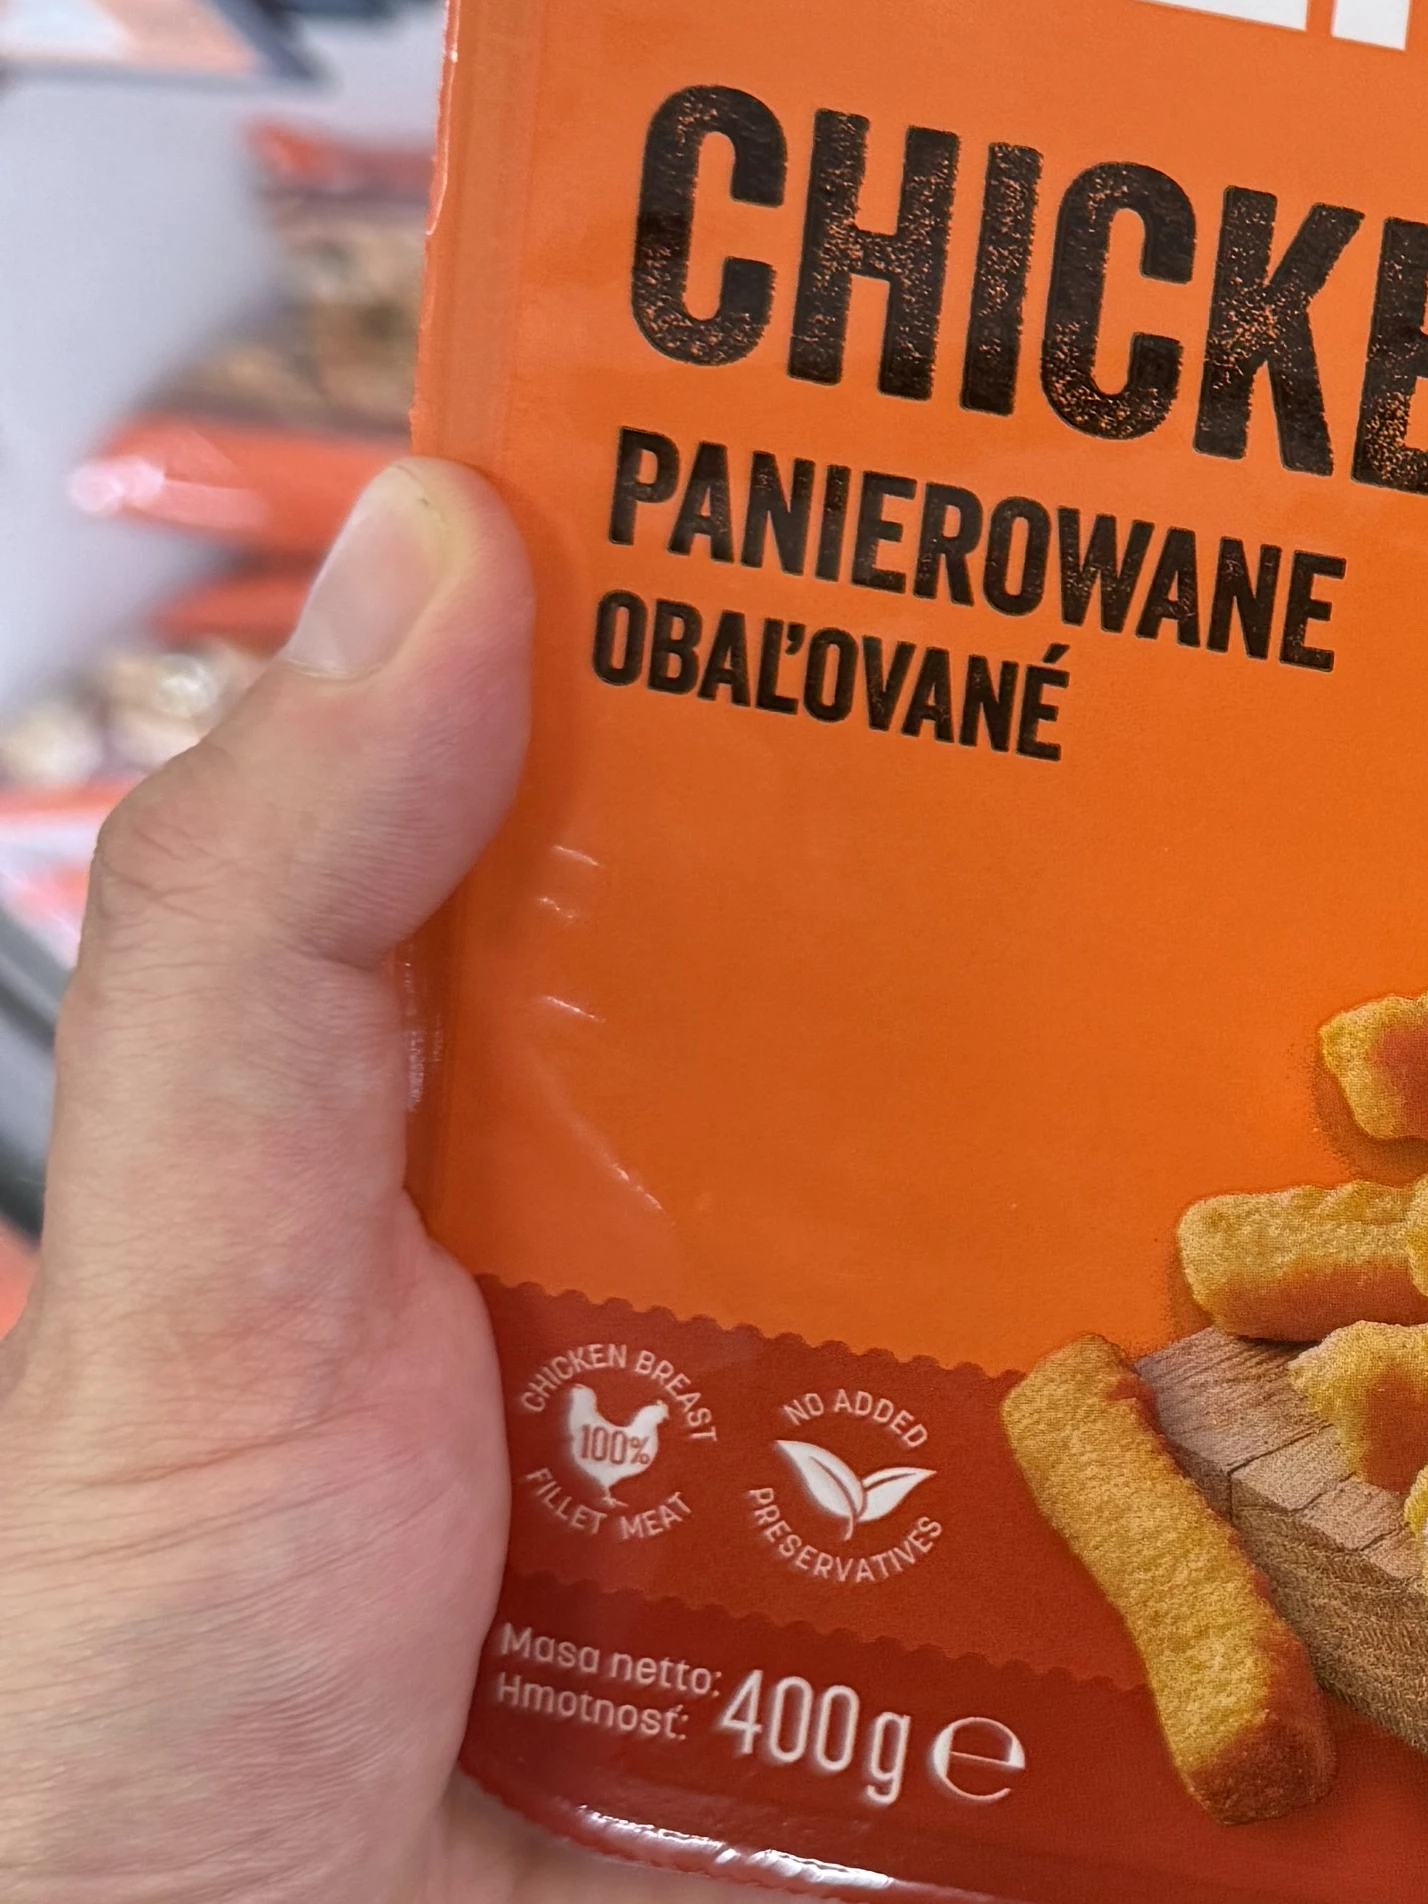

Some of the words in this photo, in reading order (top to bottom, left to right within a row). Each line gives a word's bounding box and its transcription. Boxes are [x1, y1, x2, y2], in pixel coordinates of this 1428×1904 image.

[605, 425, 1348, 675] PANIEROWANE
[591, 589, 1071, 764] OBAĽOVANÉ
[520, 1342, 628, 1415] CHICKEN
[634, 1349, 718, 1445] BREAST
[782, 1393, 826, 1427] NO
[833, 1387, 931, 1450] ADDED
[578, 1422, 650, 1467] 100%
[524, 1466, 608, 1536] FILLET
[619, 1490, 694, 1541] MEAT
[748, 1485, 945, 1585] PRESERVATIVES
[500, 1621, 600, 1675] Masa
[610, 1650, 722, 1698] netto:
[497, 1670, 689, 1742] Hmotnosť:
